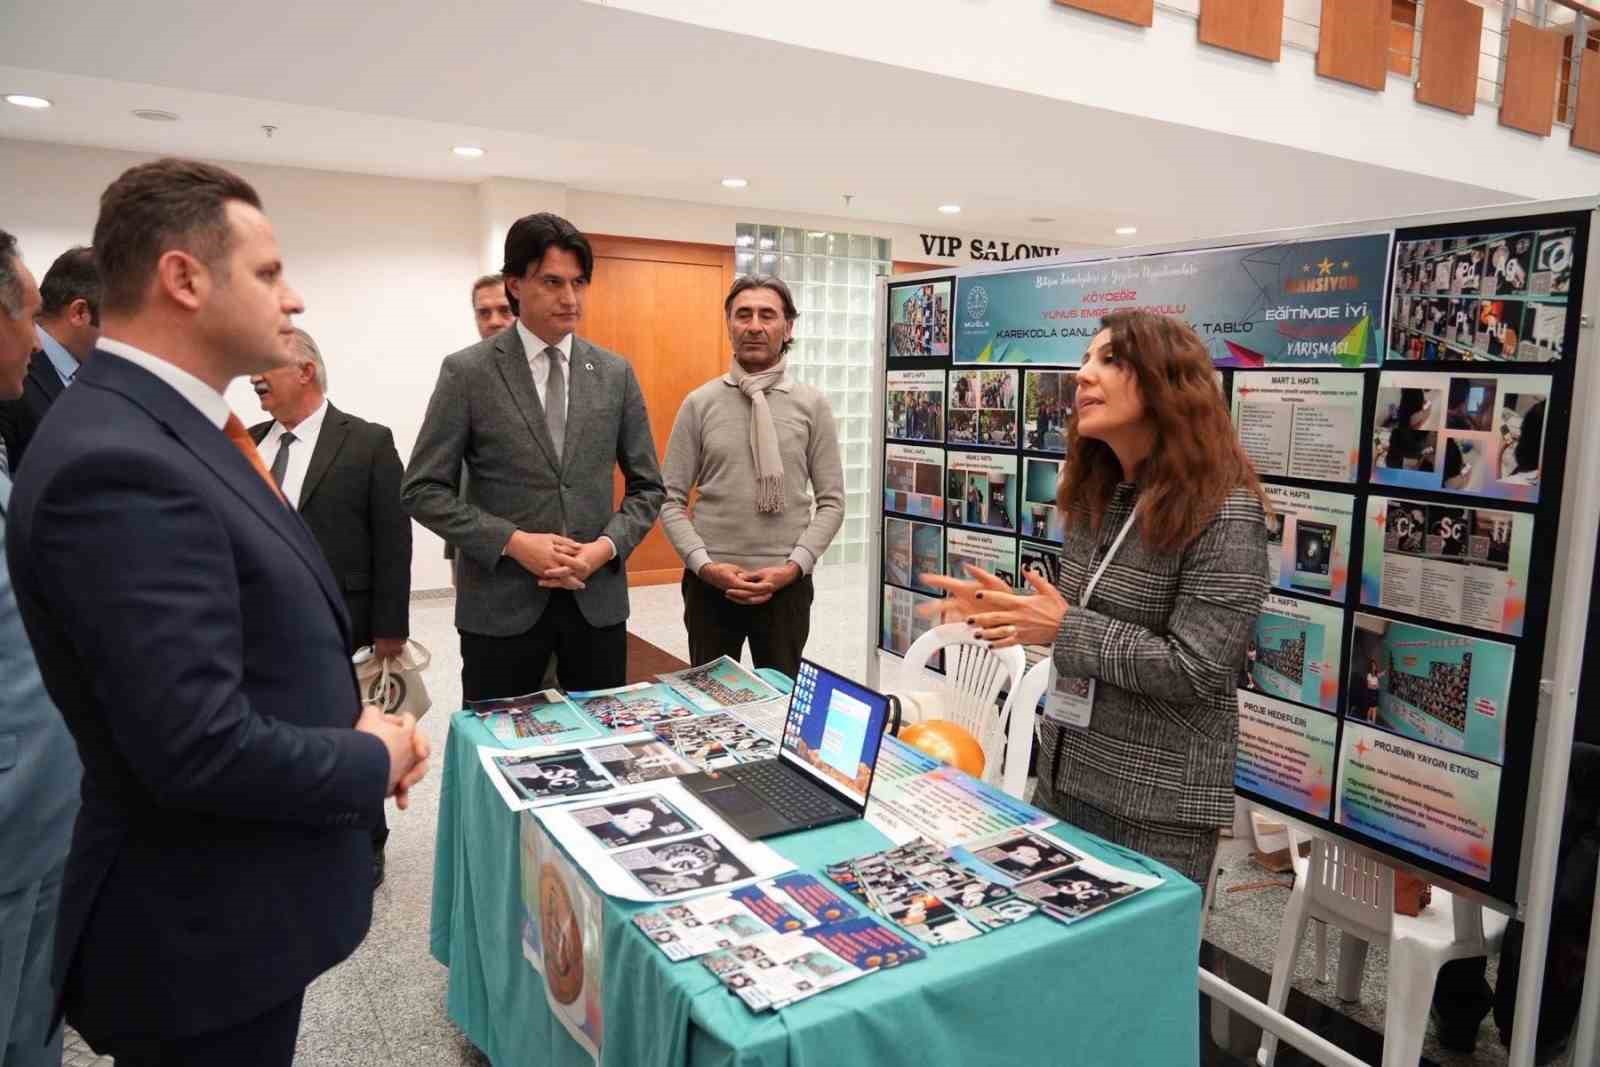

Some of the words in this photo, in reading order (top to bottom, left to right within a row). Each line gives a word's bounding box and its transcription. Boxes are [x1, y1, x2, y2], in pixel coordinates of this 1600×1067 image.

[920, 234, 962, 257] VIP
[1266, 305, 1340, 321] EĞİTİMDE
[1203, 321, 1254, 334] TABLO
